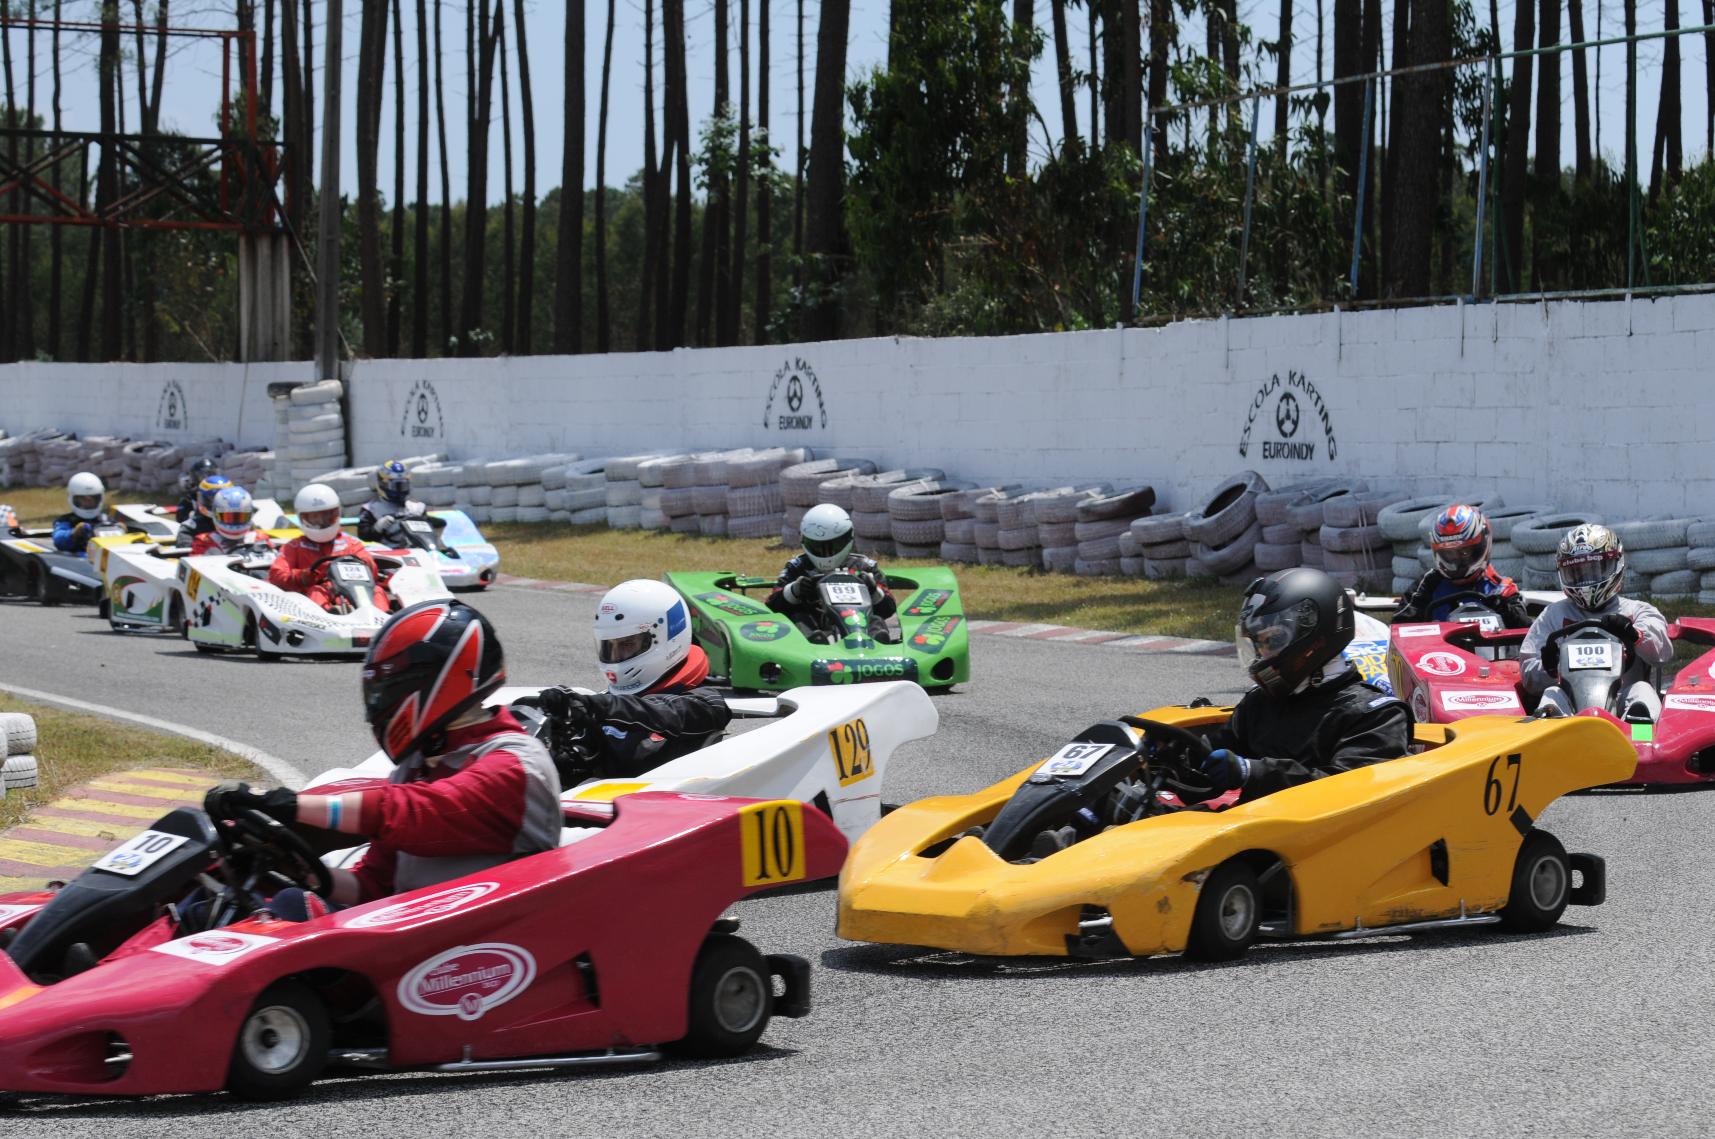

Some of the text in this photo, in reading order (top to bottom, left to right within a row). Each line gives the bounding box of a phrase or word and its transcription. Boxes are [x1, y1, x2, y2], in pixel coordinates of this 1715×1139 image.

[779, 415, 813, 430] EUROINDY
[1239, 369, 1338, 461] ESCOLA KARTING
[1262, 441, 1315, 460] EUROINDY
[1586, 554, 1604, 562] bcp
[1576, 646, 1604, 655] 100
[857, 664, 904, 681] JOGOS
[829, 718, 871, 781] 129
[1063, 745, 1106, 759] 67
[1484, 753, 1521, 816] 67
[132, 834, 174, 853] 10
[755, 806, 793, 880] 10
[420, 964, 511, 993] Millennium
